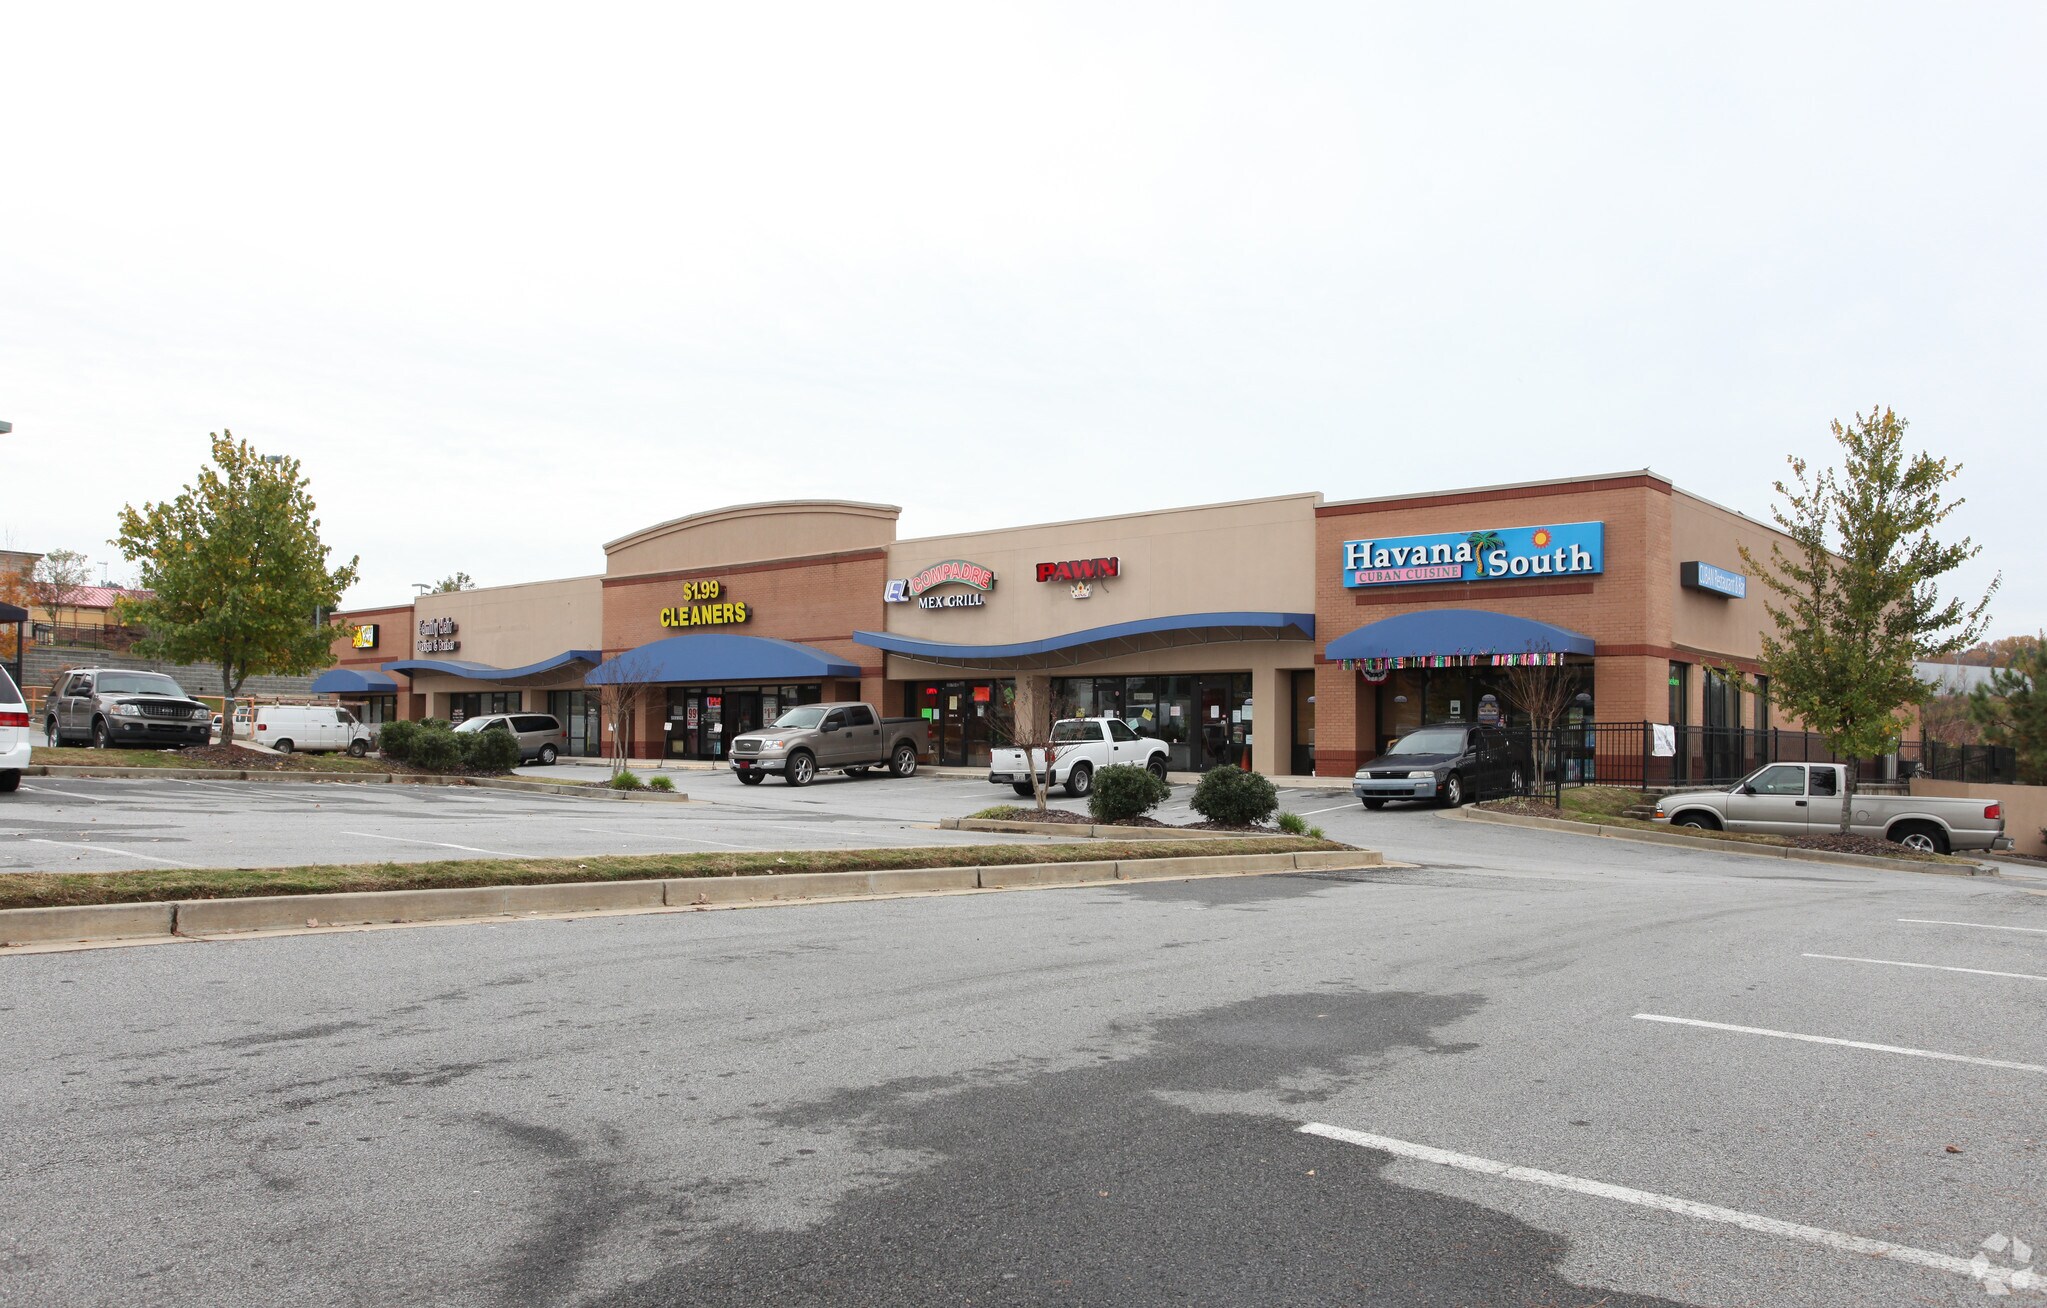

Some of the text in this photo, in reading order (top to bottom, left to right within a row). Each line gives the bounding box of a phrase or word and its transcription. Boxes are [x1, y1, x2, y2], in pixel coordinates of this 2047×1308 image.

[1036, 556, 1119, 583] PAWN
[1345, 541, 1593, 577] Havana South
[884, 562, 993, 603] EL COMPADRE
[1359, 566, 1459, 583] CUBAN CUISINE
[683, 580, 720, 602] $1.99
[918, 594, 983, 609] MEX GRILL
[660, 601, 747, 628] CLEANERS
